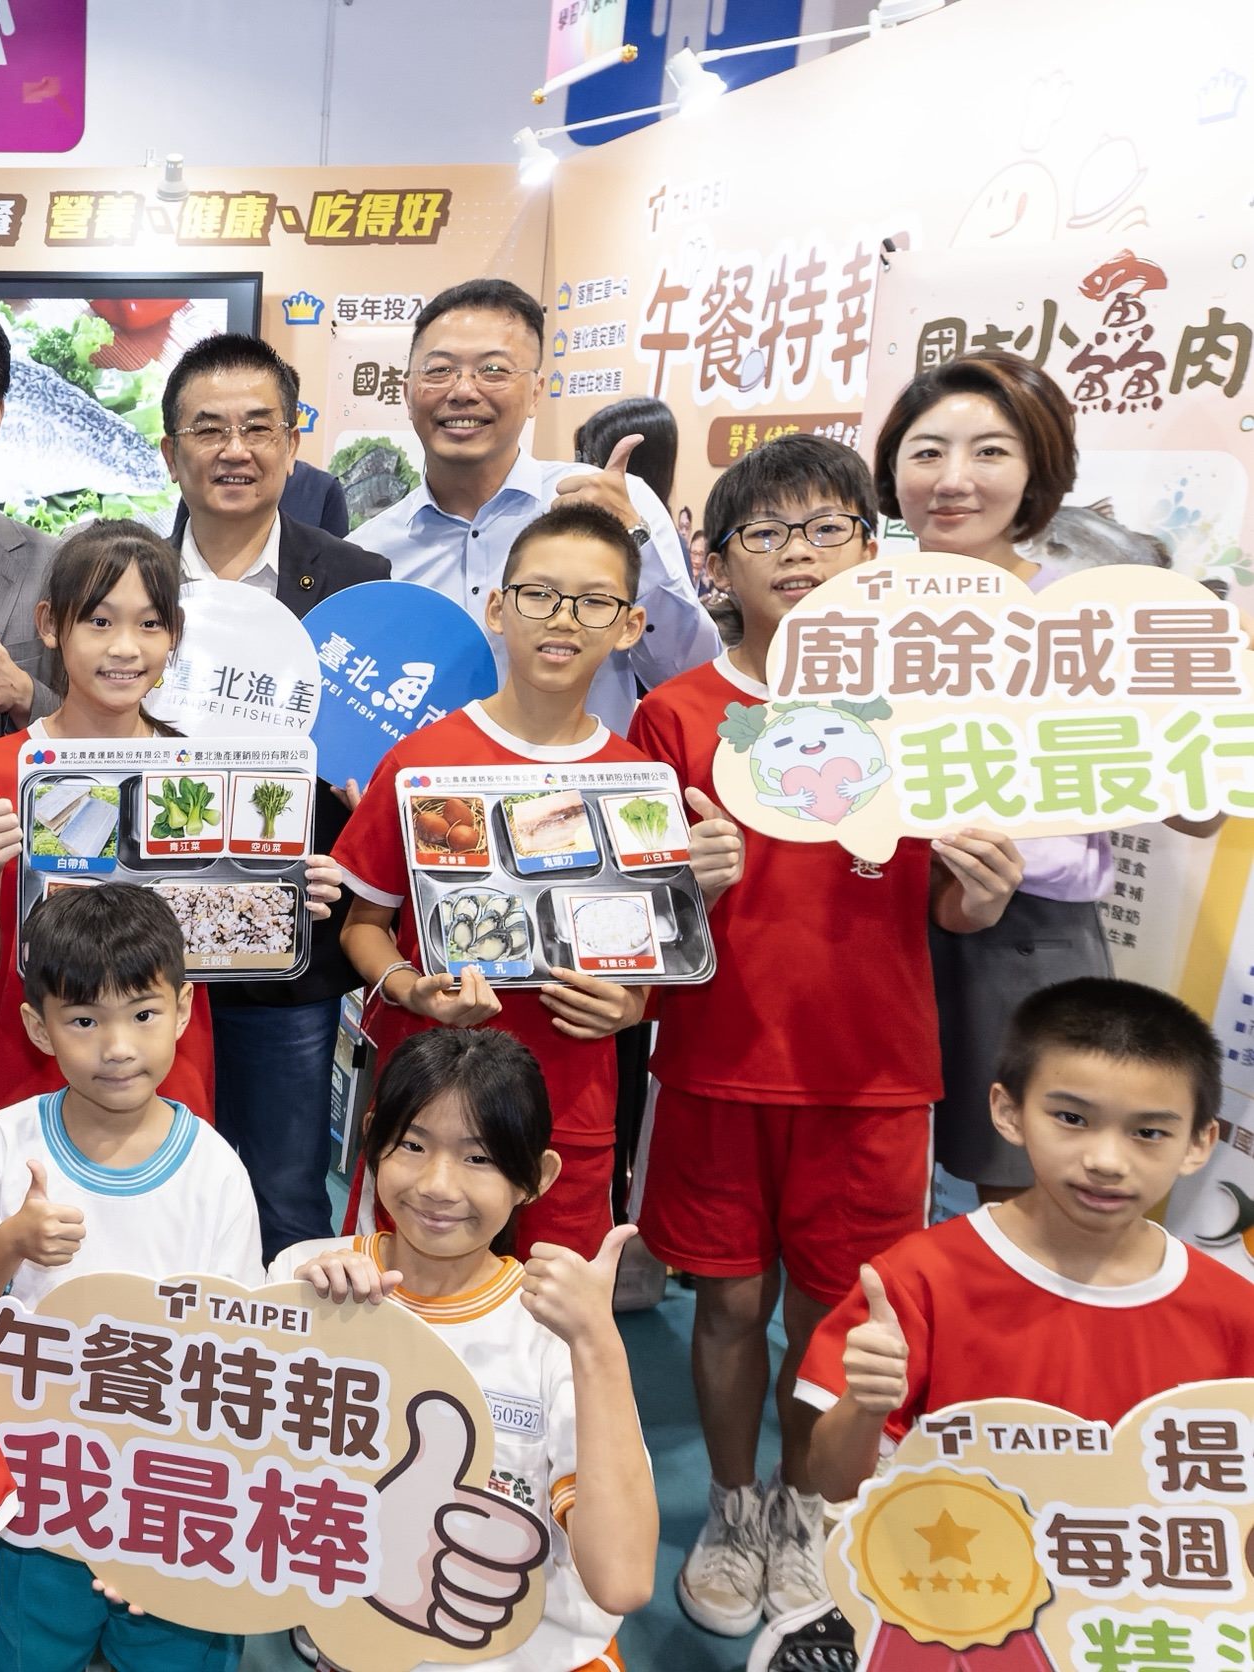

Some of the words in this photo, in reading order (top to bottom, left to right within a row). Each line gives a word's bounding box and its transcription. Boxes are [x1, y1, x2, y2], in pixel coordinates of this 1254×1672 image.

[353, 362, 410, 405] 國產
[906, 577, 1002, 596] TAIPEI
[777, 608, 1242, 697] 廚餘減量
[232, 705, 307, 729] FISHERY
[347, 696, 377, 721] FISH
[900, 711, 1254, 821] 我最行
[169, 841, 201, 852] 青江菜
[250, 842, 282, 853] 空心菜
[642, 851, 673, 863] 小白菜
[56, 858, 89, 871] 白帶魚
[210, 1298, 309, 1333] TAIPEI
[988, 1427, 1109, 1451] TAIPEI
[8, 1431, 369, 1596] 我最棒
[1045, 1513, 1233, 1590] 每週
